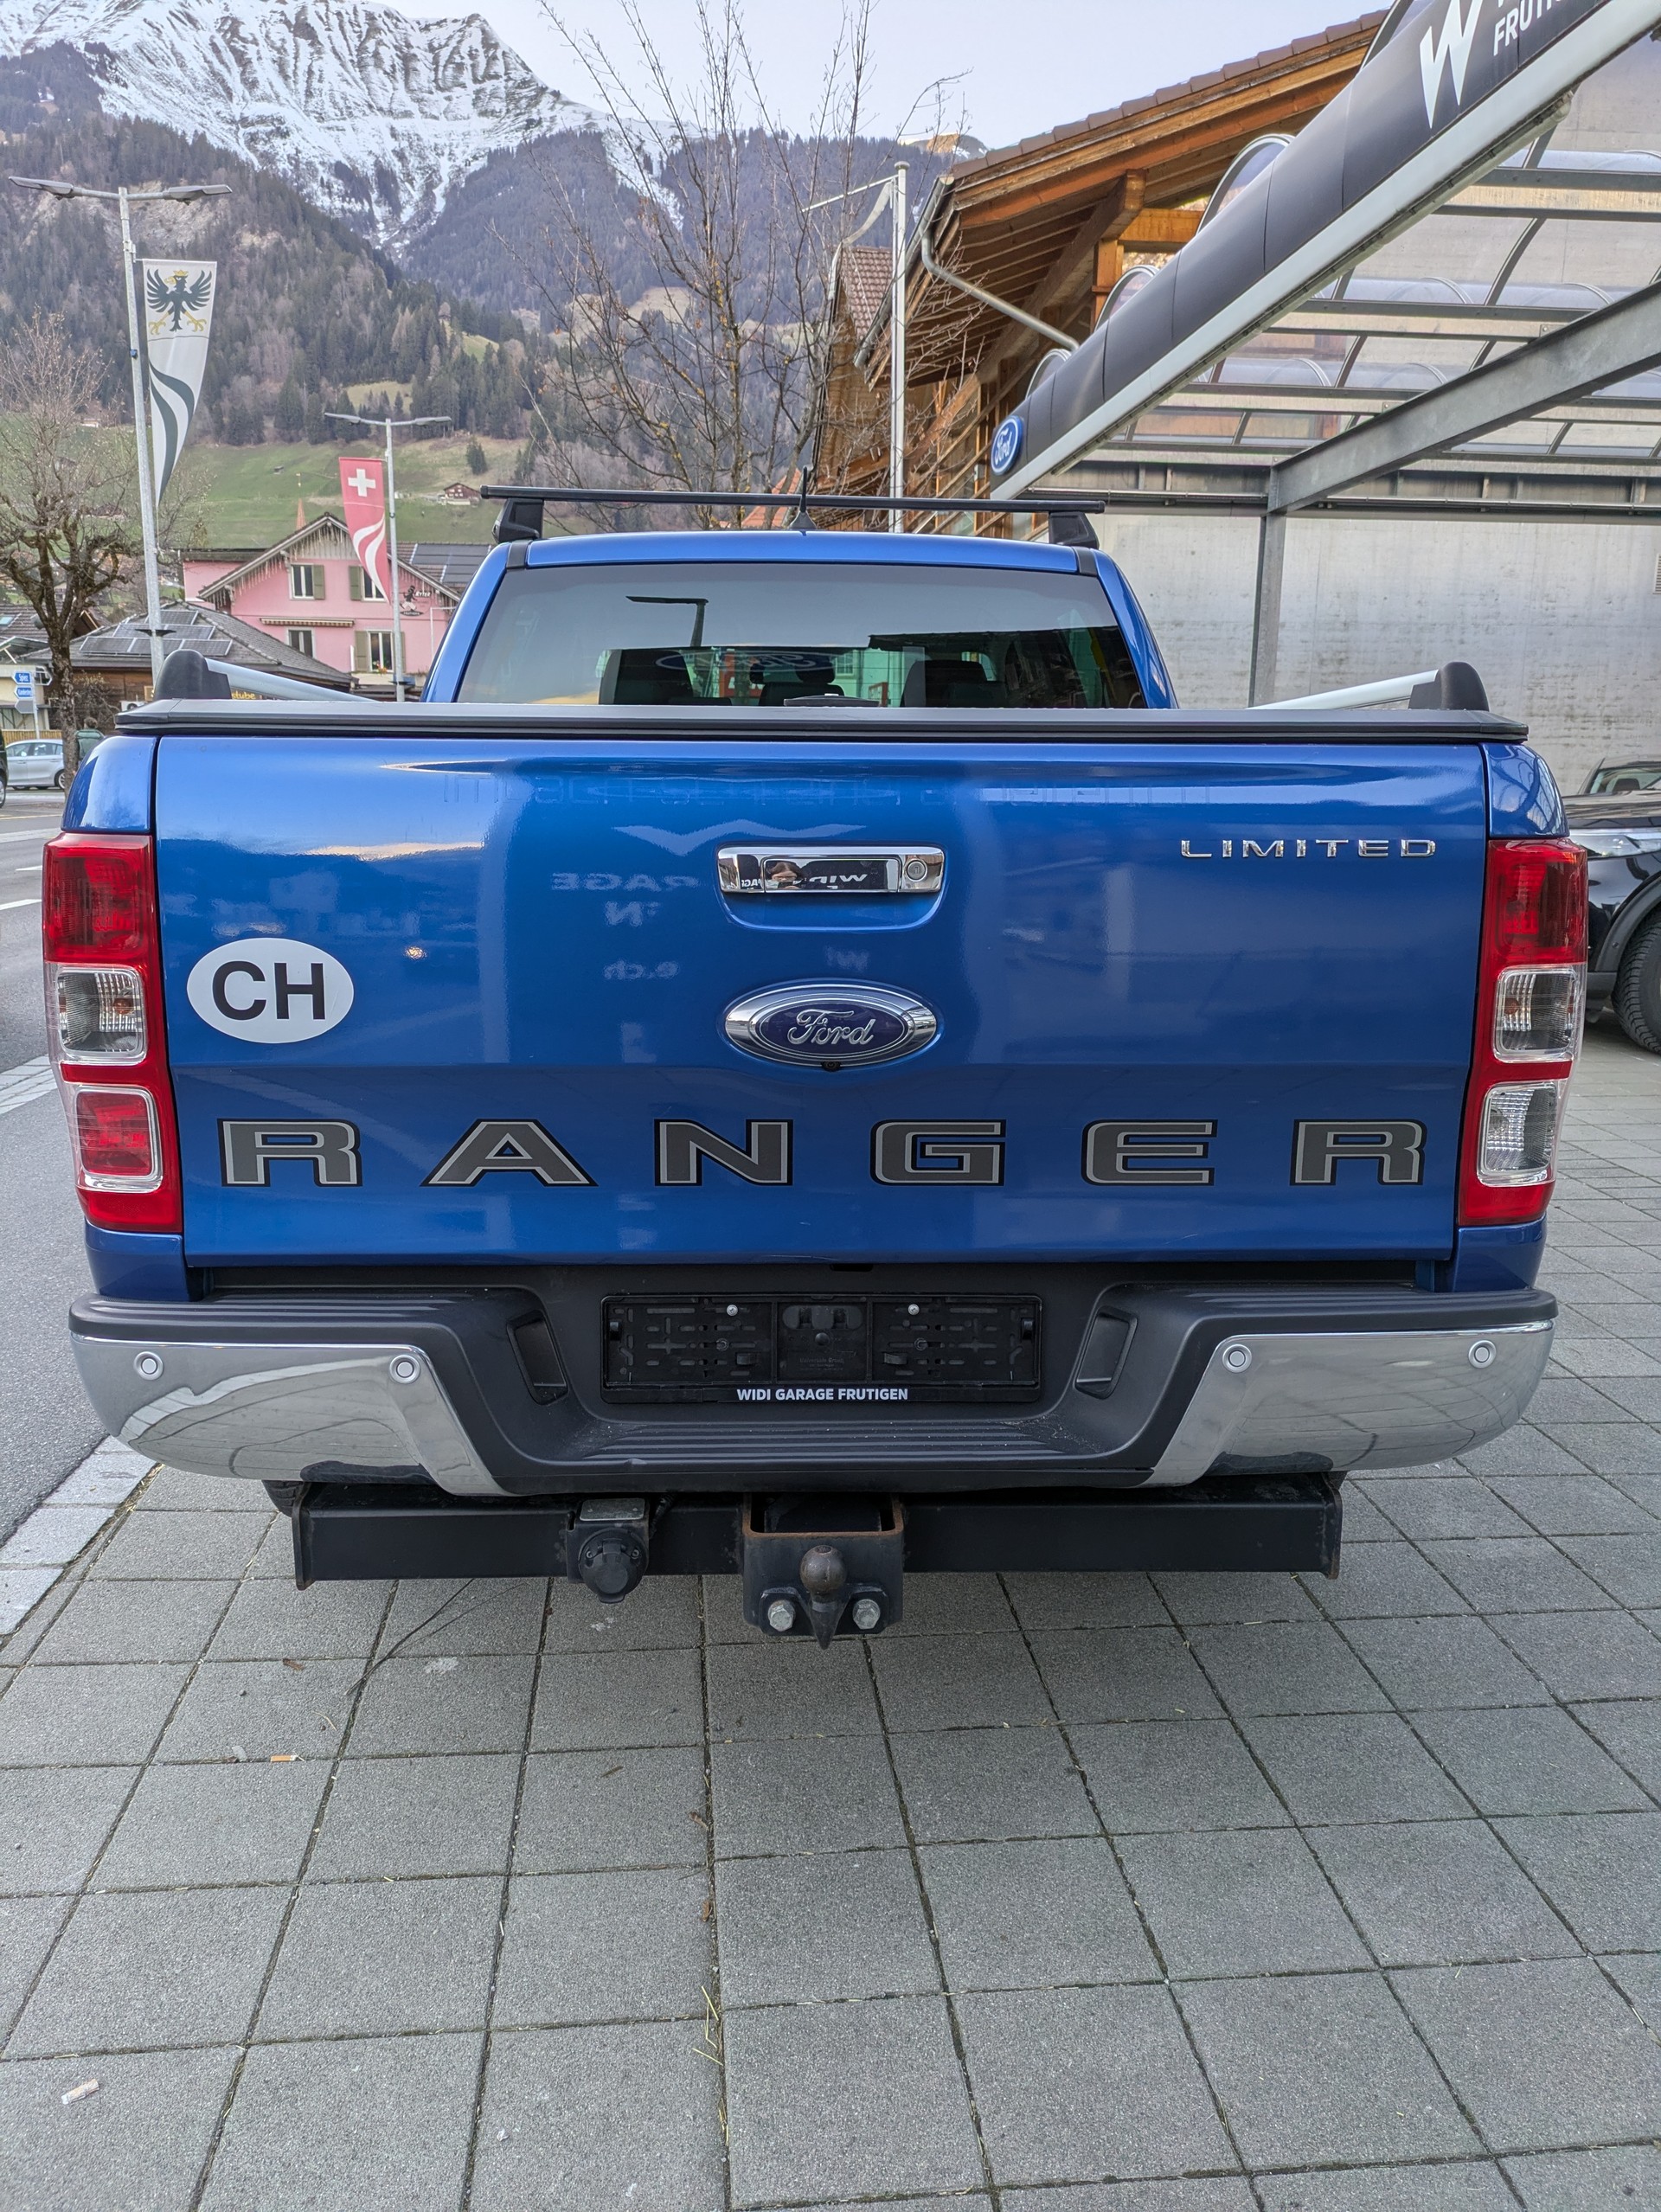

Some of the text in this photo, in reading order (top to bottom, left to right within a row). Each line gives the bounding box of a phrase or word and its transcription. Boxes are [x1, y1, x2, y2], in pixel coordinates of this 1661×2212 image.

[995, 427, 1012, 465] Ford
[232, 689, 256, 700] stube
[1181, 839, 1436, 858] LIMITED
[213, 960, 326, 1021] CH
[786, 1008, 875, 1046] Ford
[217, 1119, 1427, 1187] RANGER
[736, 1388, 909, 1401] WIDI GARAGE FRUTIGEN
